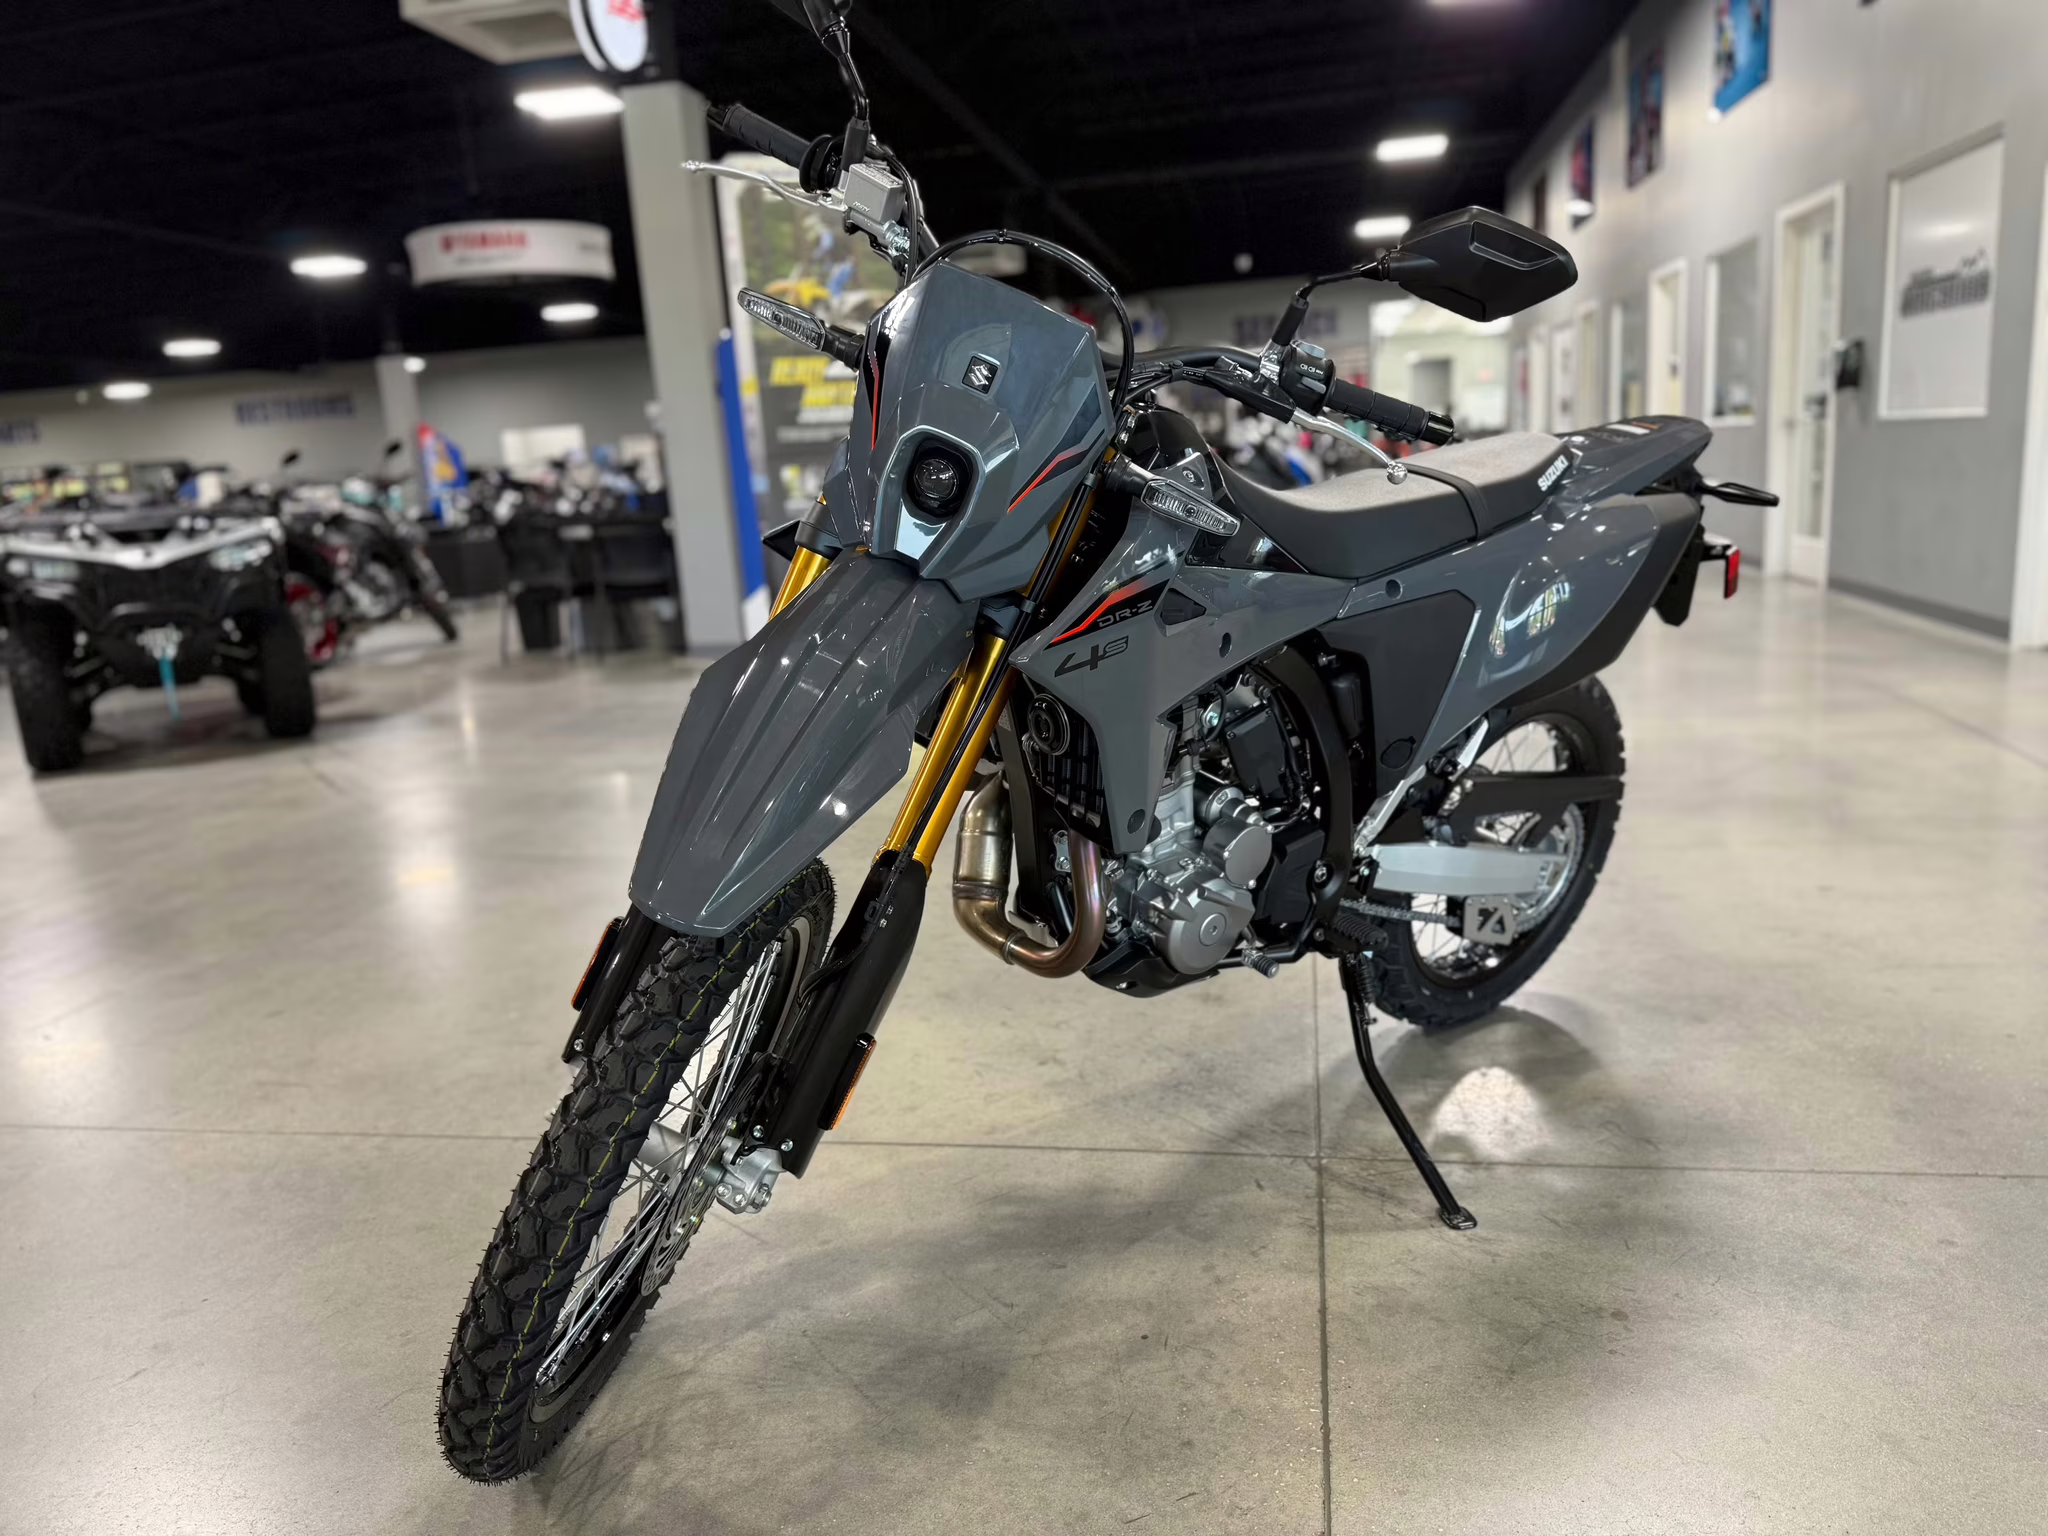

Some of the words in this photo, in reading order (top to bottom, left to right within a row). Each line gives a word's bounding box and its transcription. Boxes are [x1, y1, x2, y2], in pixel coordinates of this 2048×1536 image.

[1537, 454, 1570, 492] SUZUKI
[1097, 599, 1154, 629] DR-Z
[1053, 635, 1129, 678] 4S
